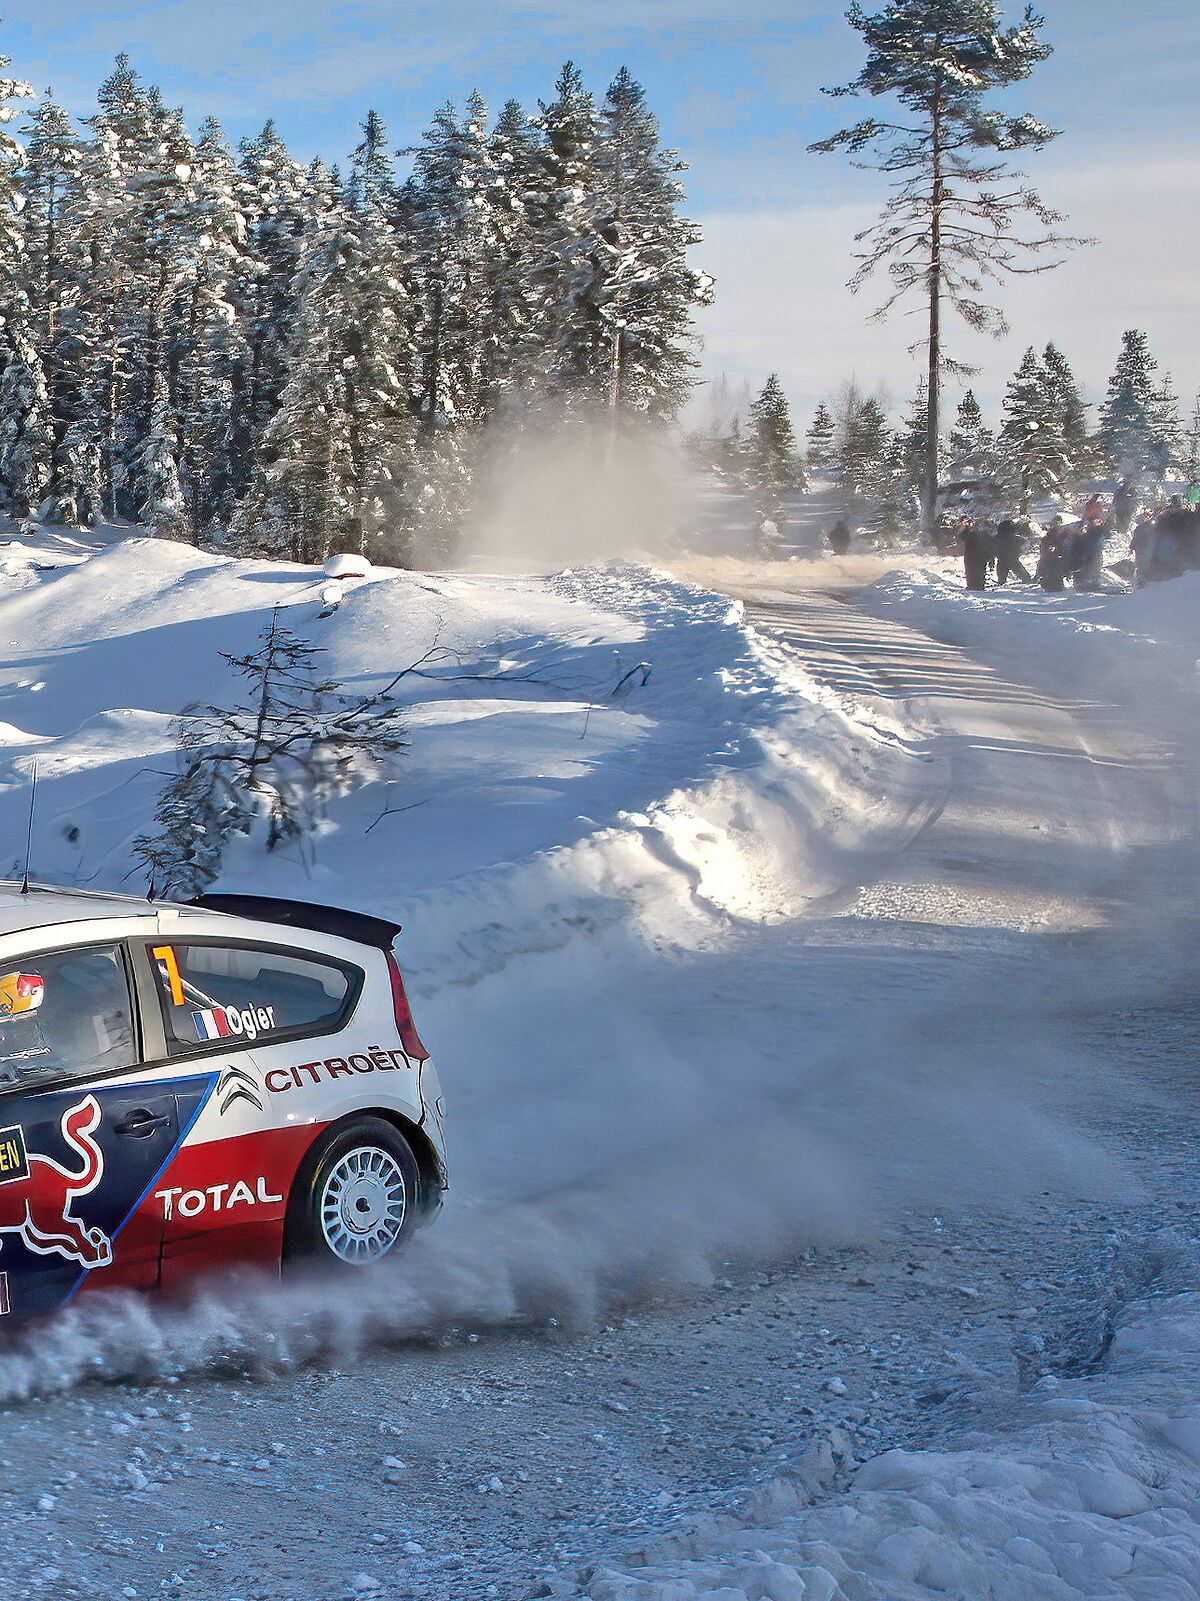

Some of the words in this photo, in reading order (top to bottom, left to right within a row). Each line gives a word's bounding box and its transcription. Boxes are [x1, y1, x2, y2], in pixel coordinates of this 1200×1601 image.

[152, 945, 186, 1006] 7
[224, 1001, 277, 1040] Ogier
[154, 1176, 283, 1221] TOTAL
